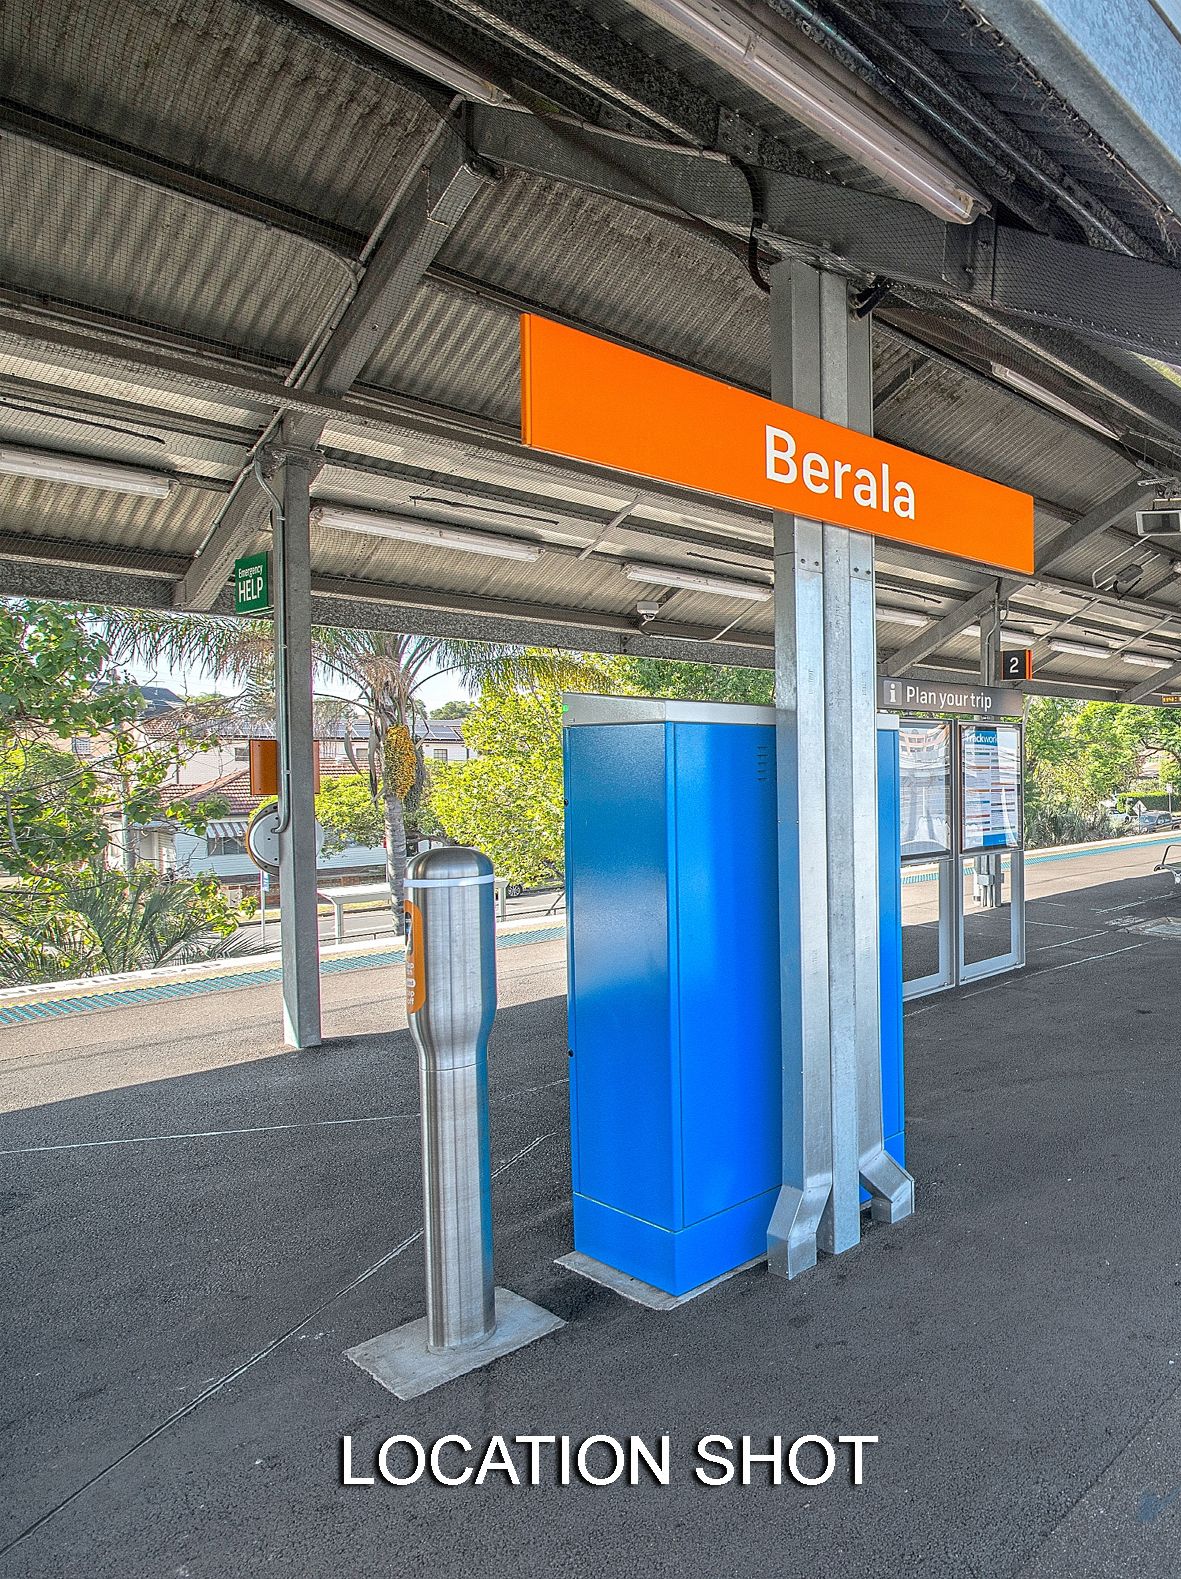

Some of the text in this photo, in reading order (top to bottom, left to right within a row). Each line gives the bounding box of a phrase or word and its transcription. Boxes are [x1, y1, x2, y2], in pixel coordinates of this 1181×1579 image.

[765, 424, 916, 521] Berala
[238, 564, 263, 579] Emergency
[238, 576, 264, 603] HELP
[1009, 656, 1019, 674] 2
[906, 685, 937, 706] Plan
[938, 692, 969, 709] your
[970, 692, 992, 712] trip
